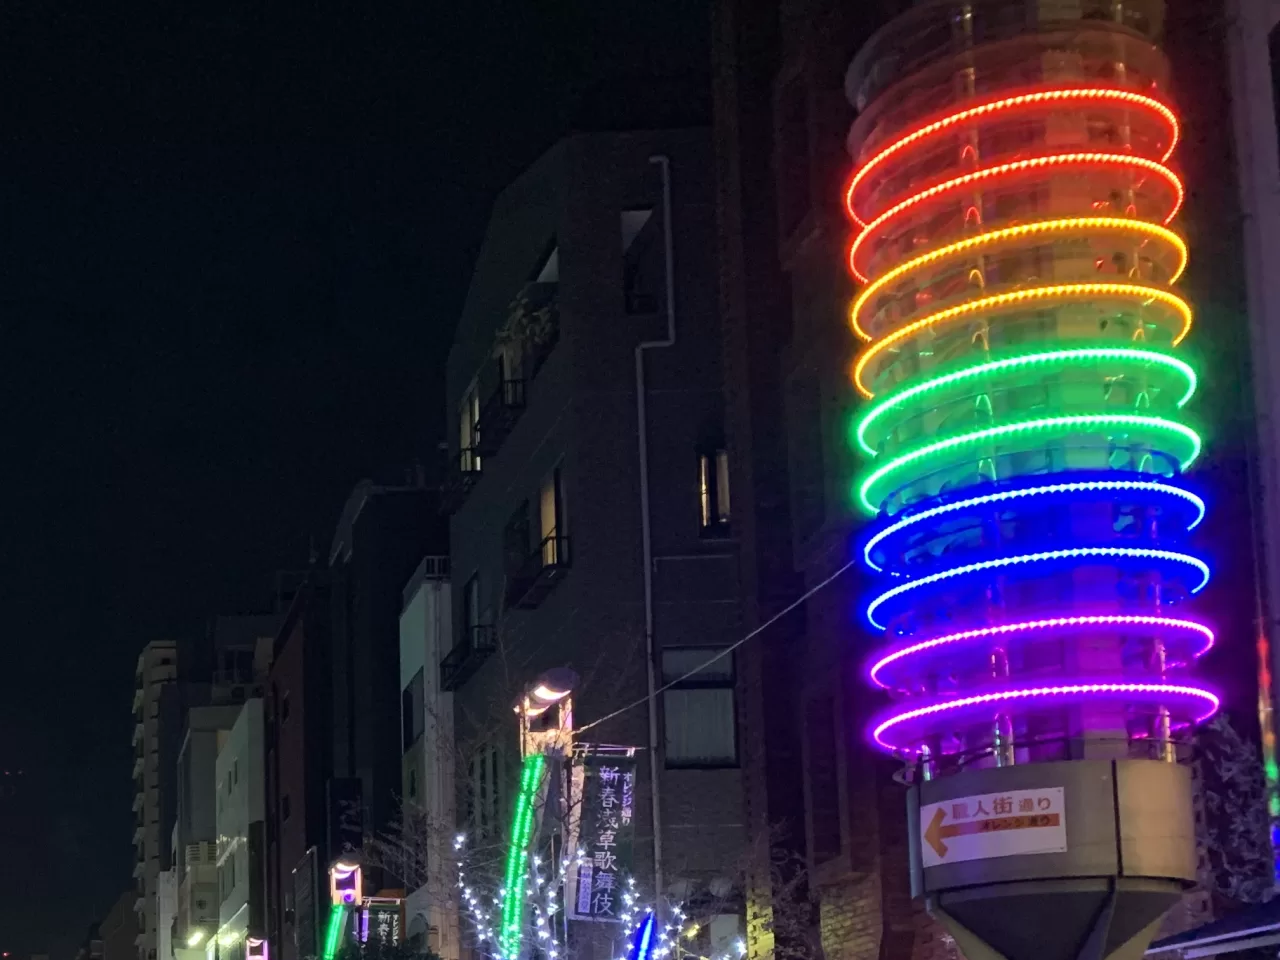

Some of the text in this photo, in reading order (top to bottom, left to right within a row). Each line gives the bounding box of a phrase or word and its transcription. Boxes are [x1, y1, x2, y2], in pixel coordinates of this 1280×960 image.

[621, 771, 632, 826] オレンジ通り
[951, 797, 1051, 820] 職人街通り
[592, 765, 620, 916] 新春浅草歌舞伎
[983, 815, 1050, 831] オレンジ通り
